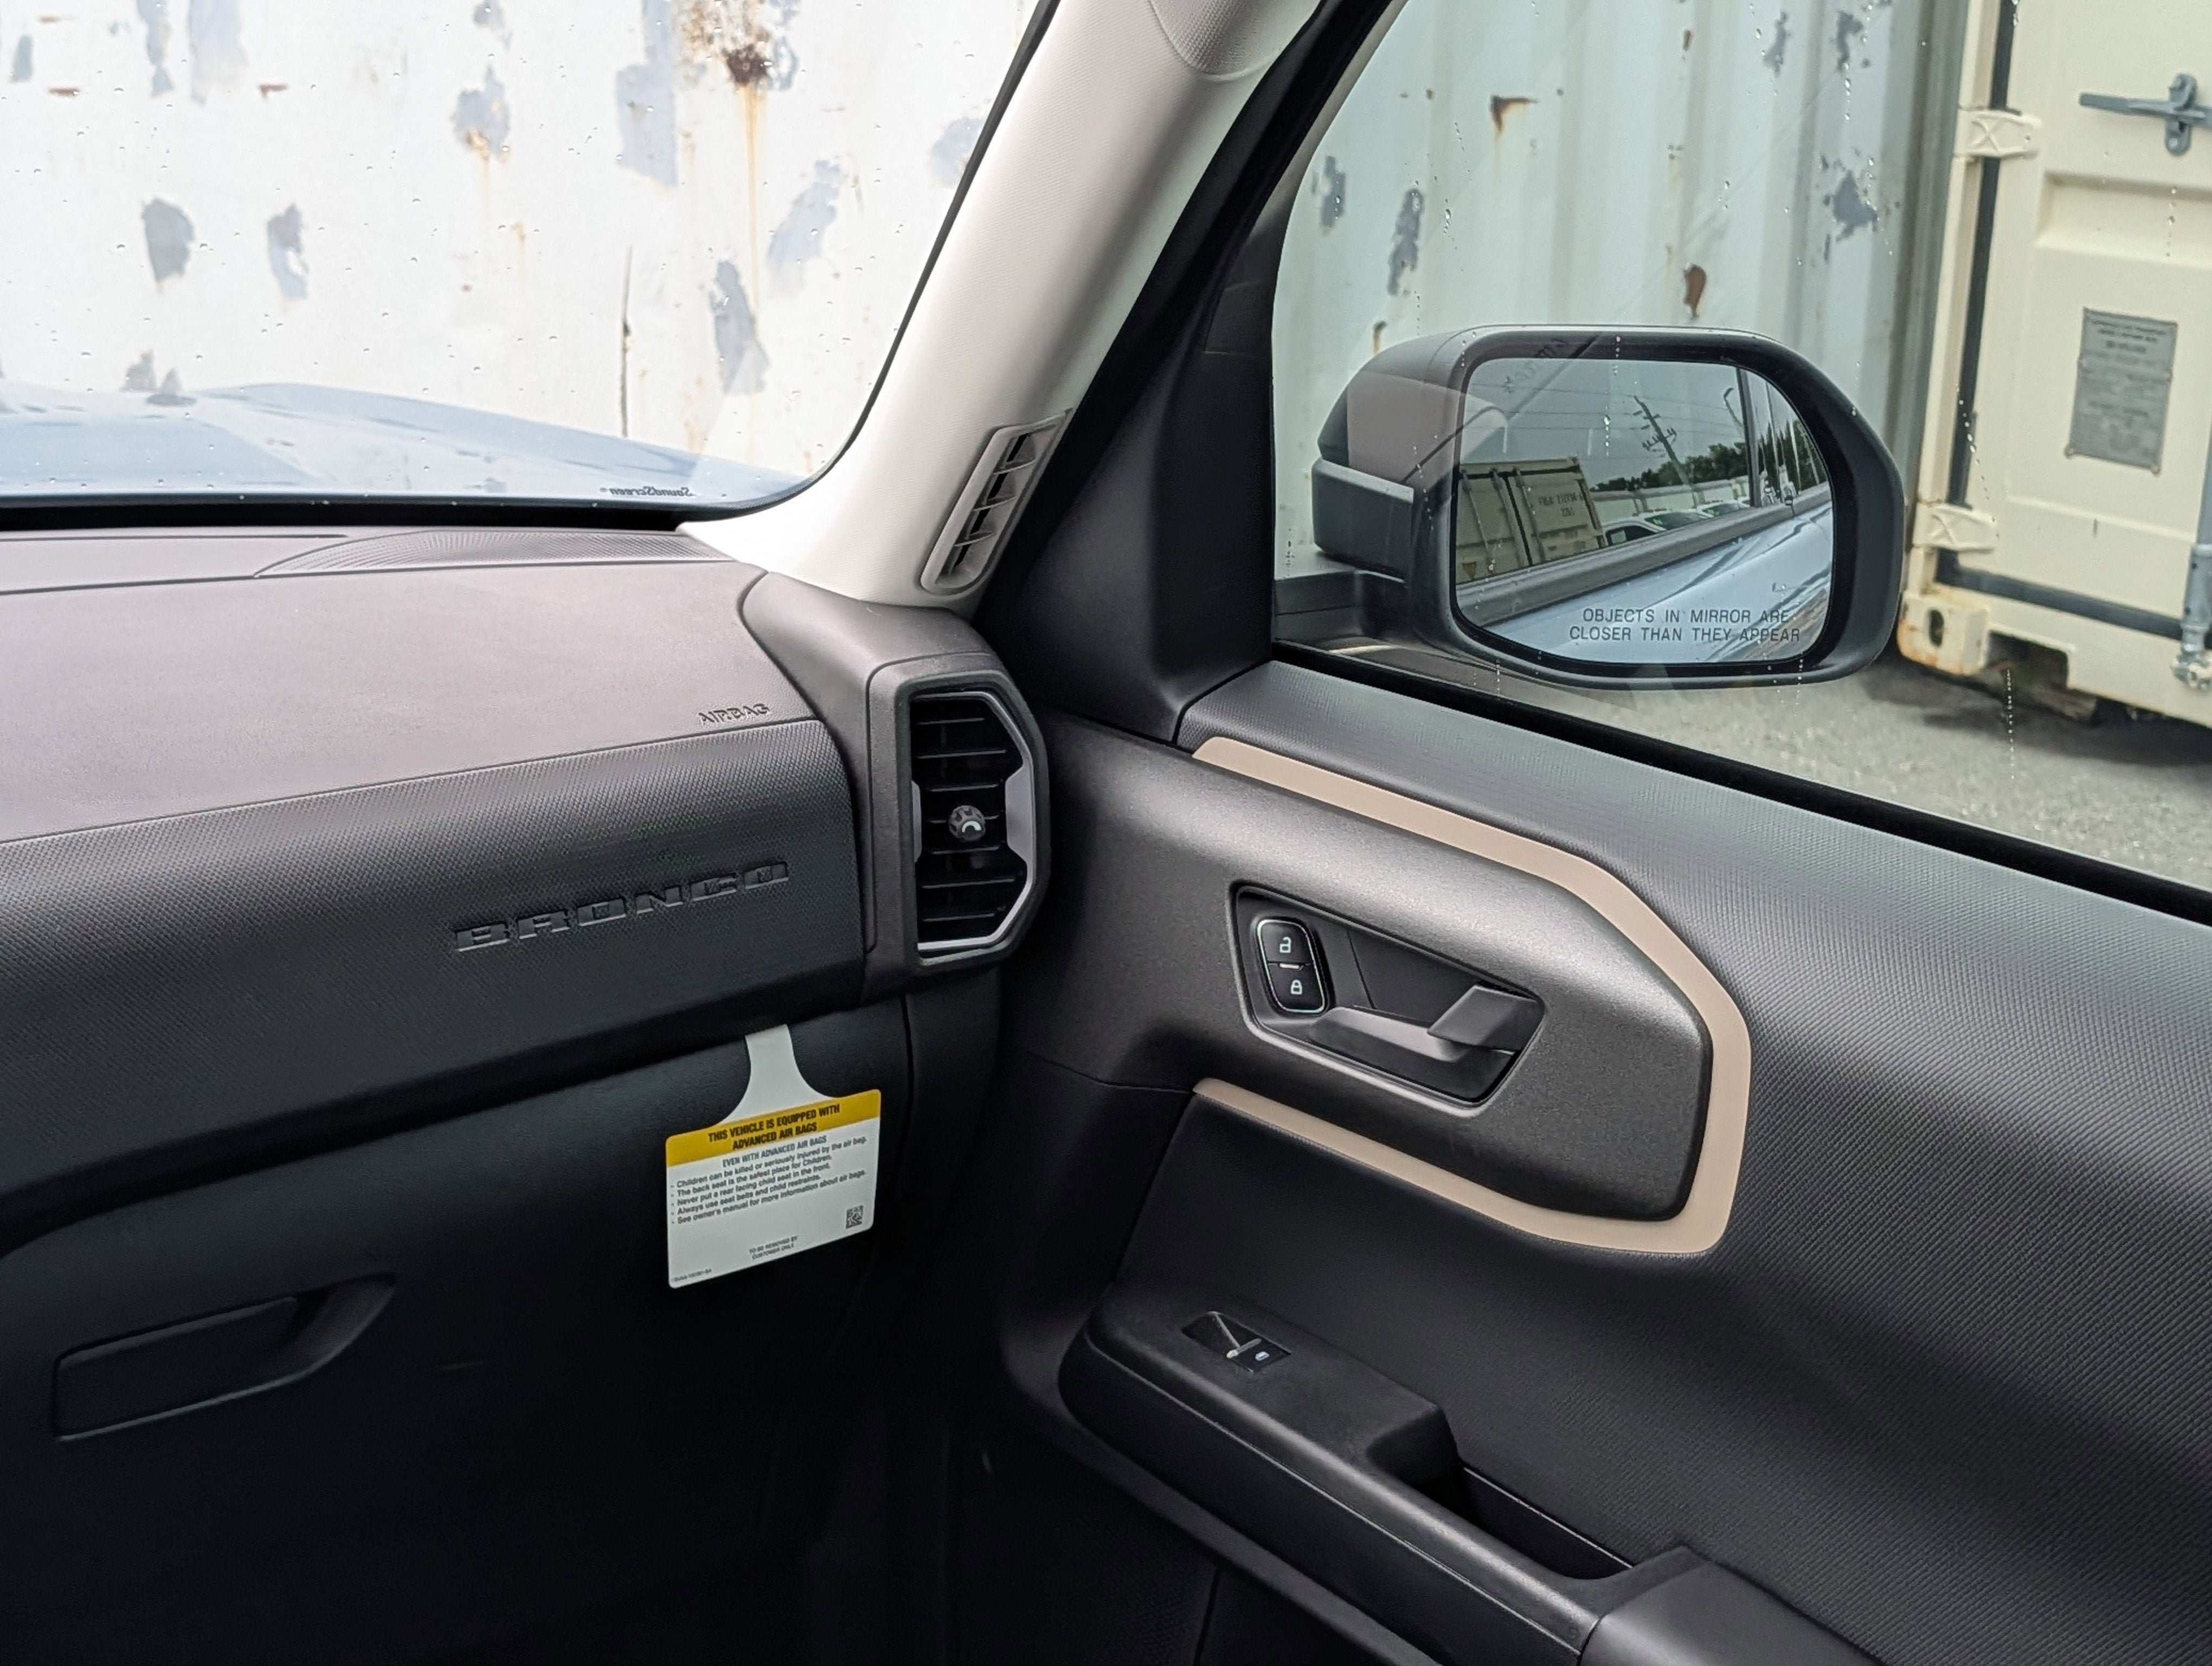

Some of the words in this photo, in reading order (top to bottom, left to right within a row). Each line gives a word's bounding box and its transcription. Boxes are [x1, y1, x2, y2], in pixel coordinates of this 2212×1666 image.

[1583, 608, 1655, 623] OBJECTS
[1665, 609, 1680, 623] IN
[1690, 609, 1751, 623] MIRROR
[1759, 610, 1790, 624] ARE
[1570, 626, 1631, 641] CLOSER
[1641, 627, 1682, 641] THAN
[1693, 627, 1732, 641] THEY
[1739, 628, 1800, 642] APPEAR
[698, 703, 770, 724] AIRBAG
[453, 861, 789, 952] BRONCO
[708, 1129, 728, 1142] THIS
[729, 1121, 764, 1137] VEHICLE
[766, 1118, 775, 1129] IS
[776, 1110, 816, 1126] EQUIPPED
[819, 1104, 840, 1117] WITH
[732, 1131, 777, 1150] ADVANCED
[779, 1127, 793, 1139] AIR
[795, 1122, 818, 1135] BAGS
[677, 1176, 708, 1188] Children
[709, 1172, 723, 1181] can
[735, 1164, 754, 1175] killed
[764, 1155, 795, 1168] seriously
[797, 1148, 820, 1159] injured
[832, 1143, 842, 1151] the
[844, 1140, 852, 1148] air
[722, 1157, 740, 1167] EVEN
[742, 1152, 759, 1163] WITH
[761, 1144, 795, 1158] ADVANCED
[797, 1140, 808, 1150] AIR
[809, 1135, 827, 1146] BAGS
[677, 1196, 698, 1206] Never
[700, 1193, 712, 1203] put
[719, 1188, 734, 1196] rear
[736, 1182, 757, 1191] facing
[758, 1176, 776, 1187] child
[777, 1172, 792, 1182] seat
[801, 1168, 812, 1176] the
[692, 1184, 710, 1194] back
[712, 1180, 726, 1189] seat
[750, 1169, 770, 1180] safest
[772, 1165, 790, 1176] place
[677, 1204, 703, 1215] Always
[720, 1196, 735, 1205] seat
[736, 1191, 754, 1201] belts
[755, 1187, 768, 1196] and
[770, 1183, 786, 1193] child
[677, 1216, 691, 1224] See
[693, 1209, 721, 1221] owner's
[723, 1201, 748, 1213] manual
[750, 1199, 760, 1207] for
[761, 1194, 779, 1203] more
[781, 1183, 818, 1198] information
[820, 1177, 838, 1188] about
